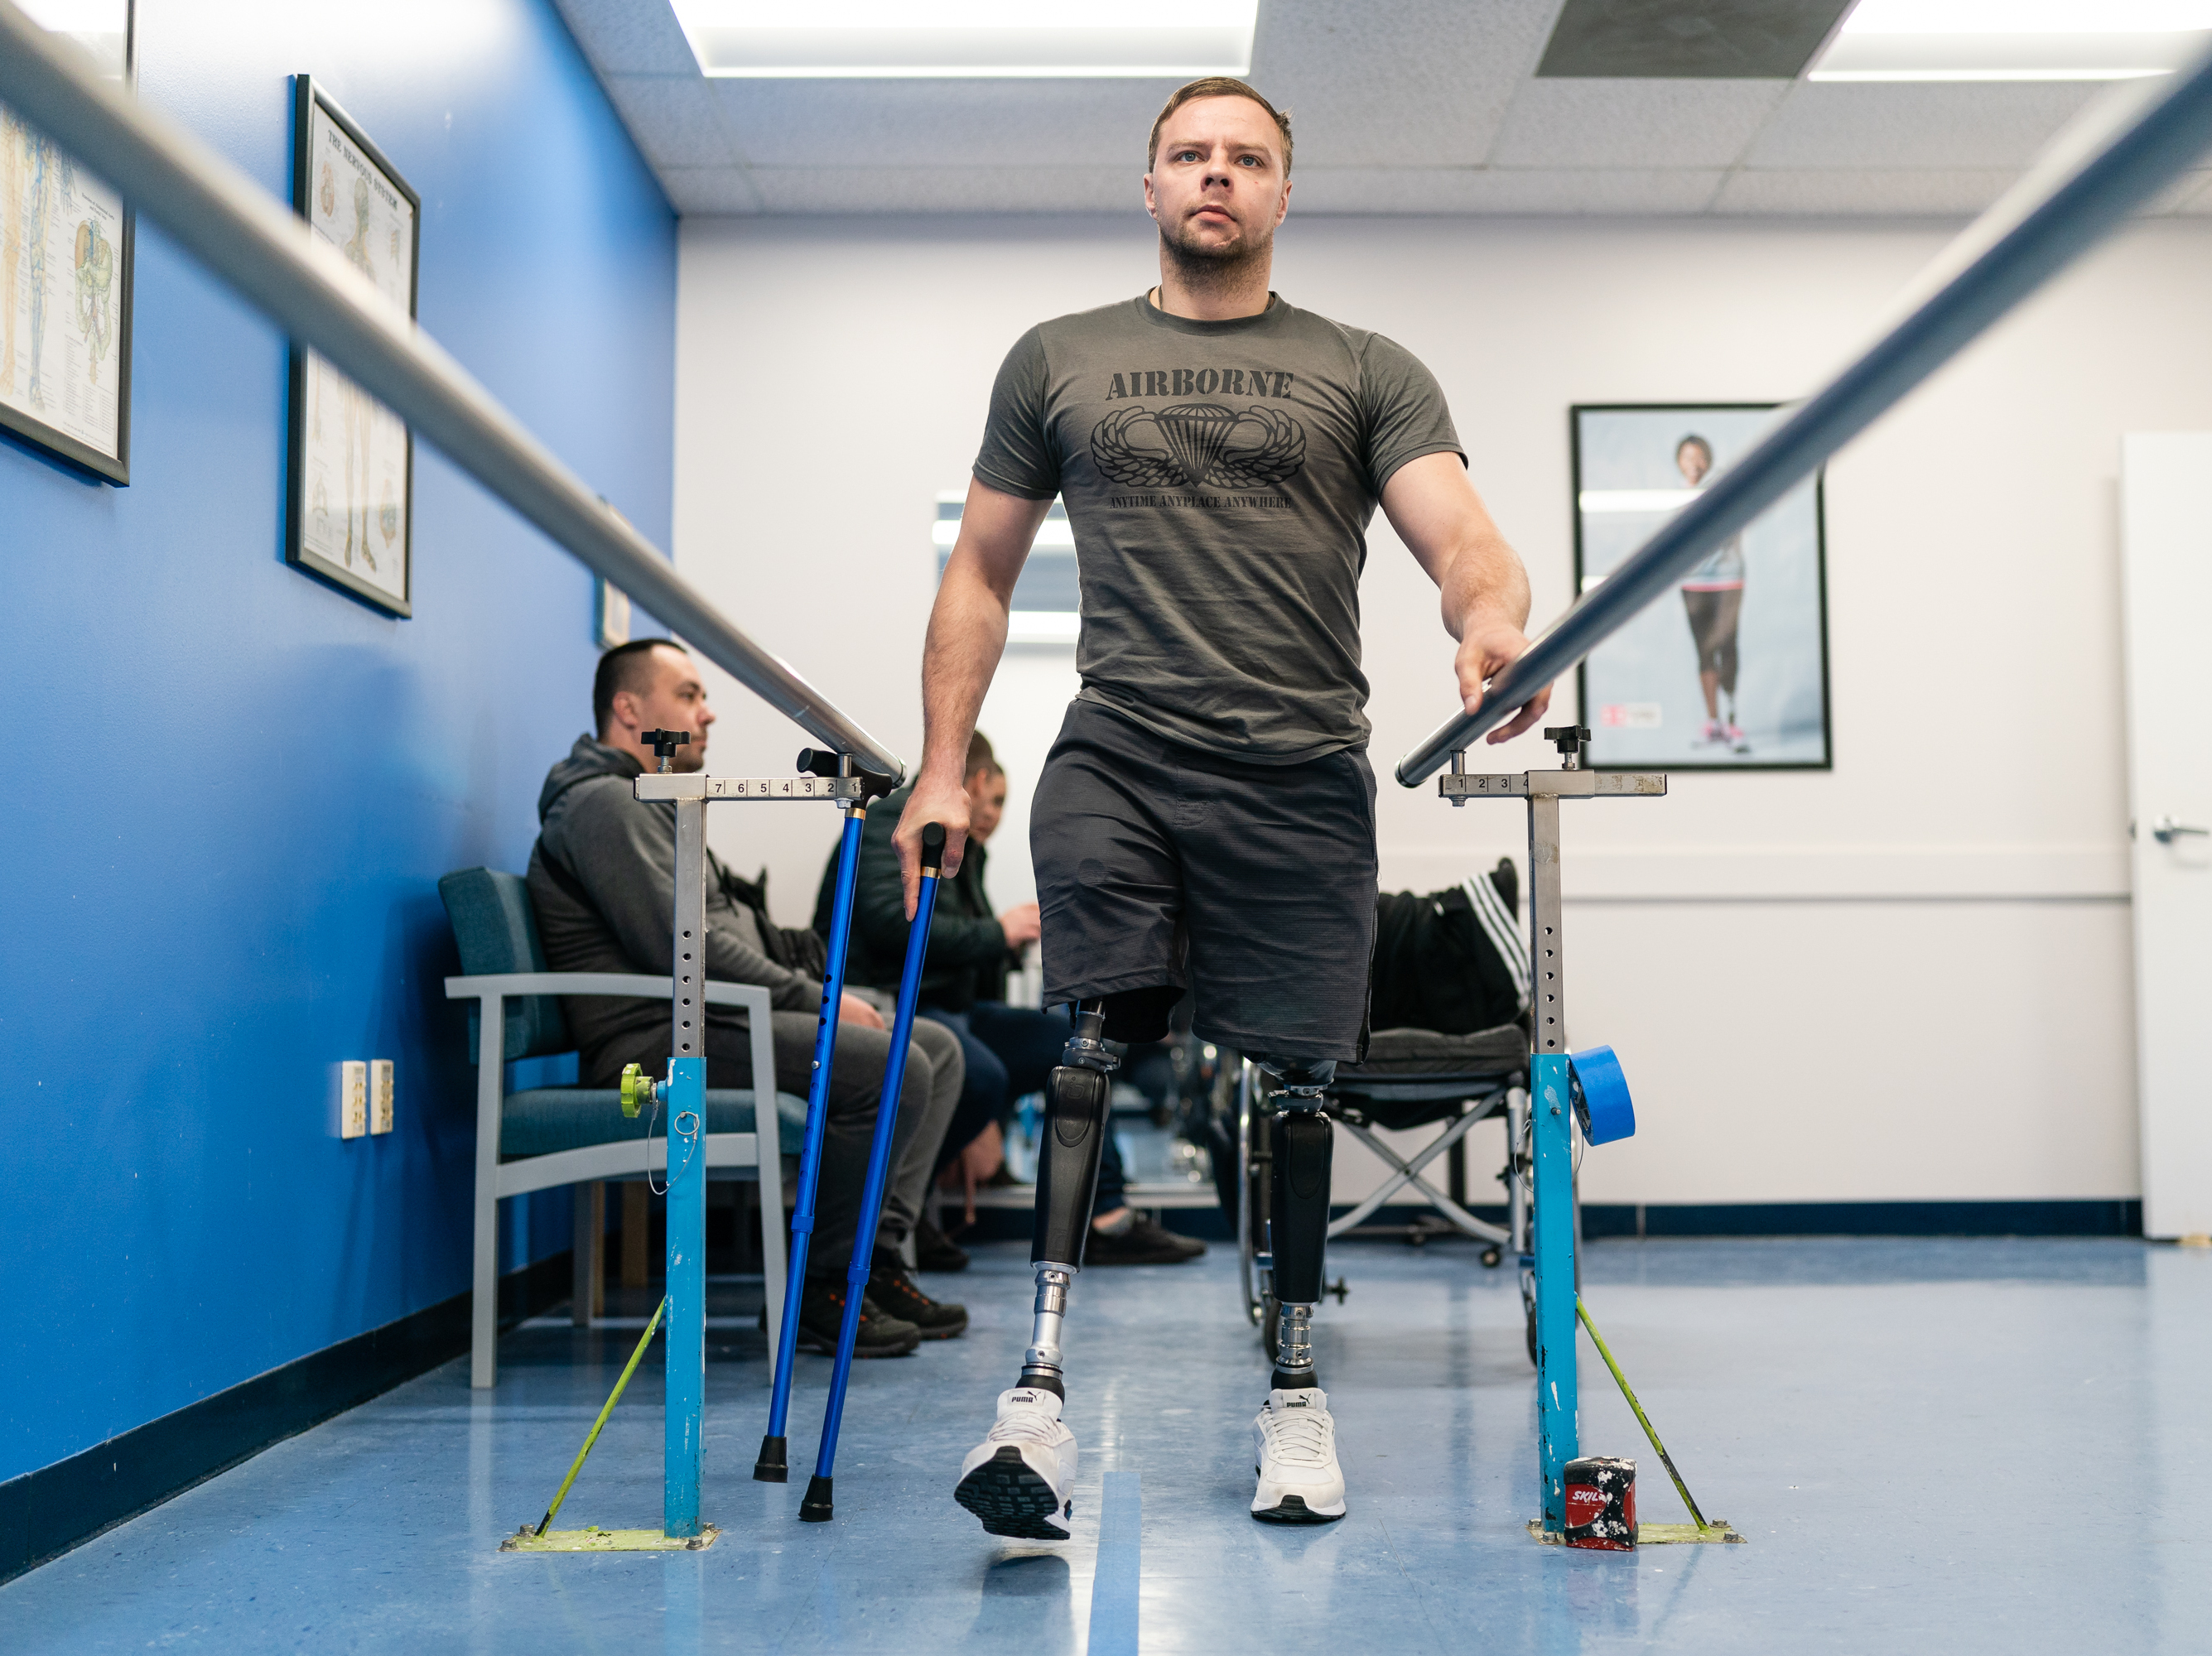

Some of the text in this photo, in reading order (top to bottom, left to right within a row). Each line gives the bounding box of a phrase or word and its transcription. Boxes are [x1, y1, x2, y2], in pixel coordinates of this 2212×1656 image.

[328, 129, 342, 152] THE
[344, 145, 372, 185] NERVOUS
[374, 177, 398, 212] SYSTEM
[1105, 368, 1294, 401] AIRBORNE
[1110, 495, 1292, 509] ANYTIME ANYPLACE ANYWHERE
[715, 782, 857, 793] 7 6 5 4 3 2 1
[1458, 778, 1463, 788] 1
[1478, 778, 1486, 788] 2
[1501, 778, 1508, 788] 3
[1572, 1490, 1598, 1503] SKIL
